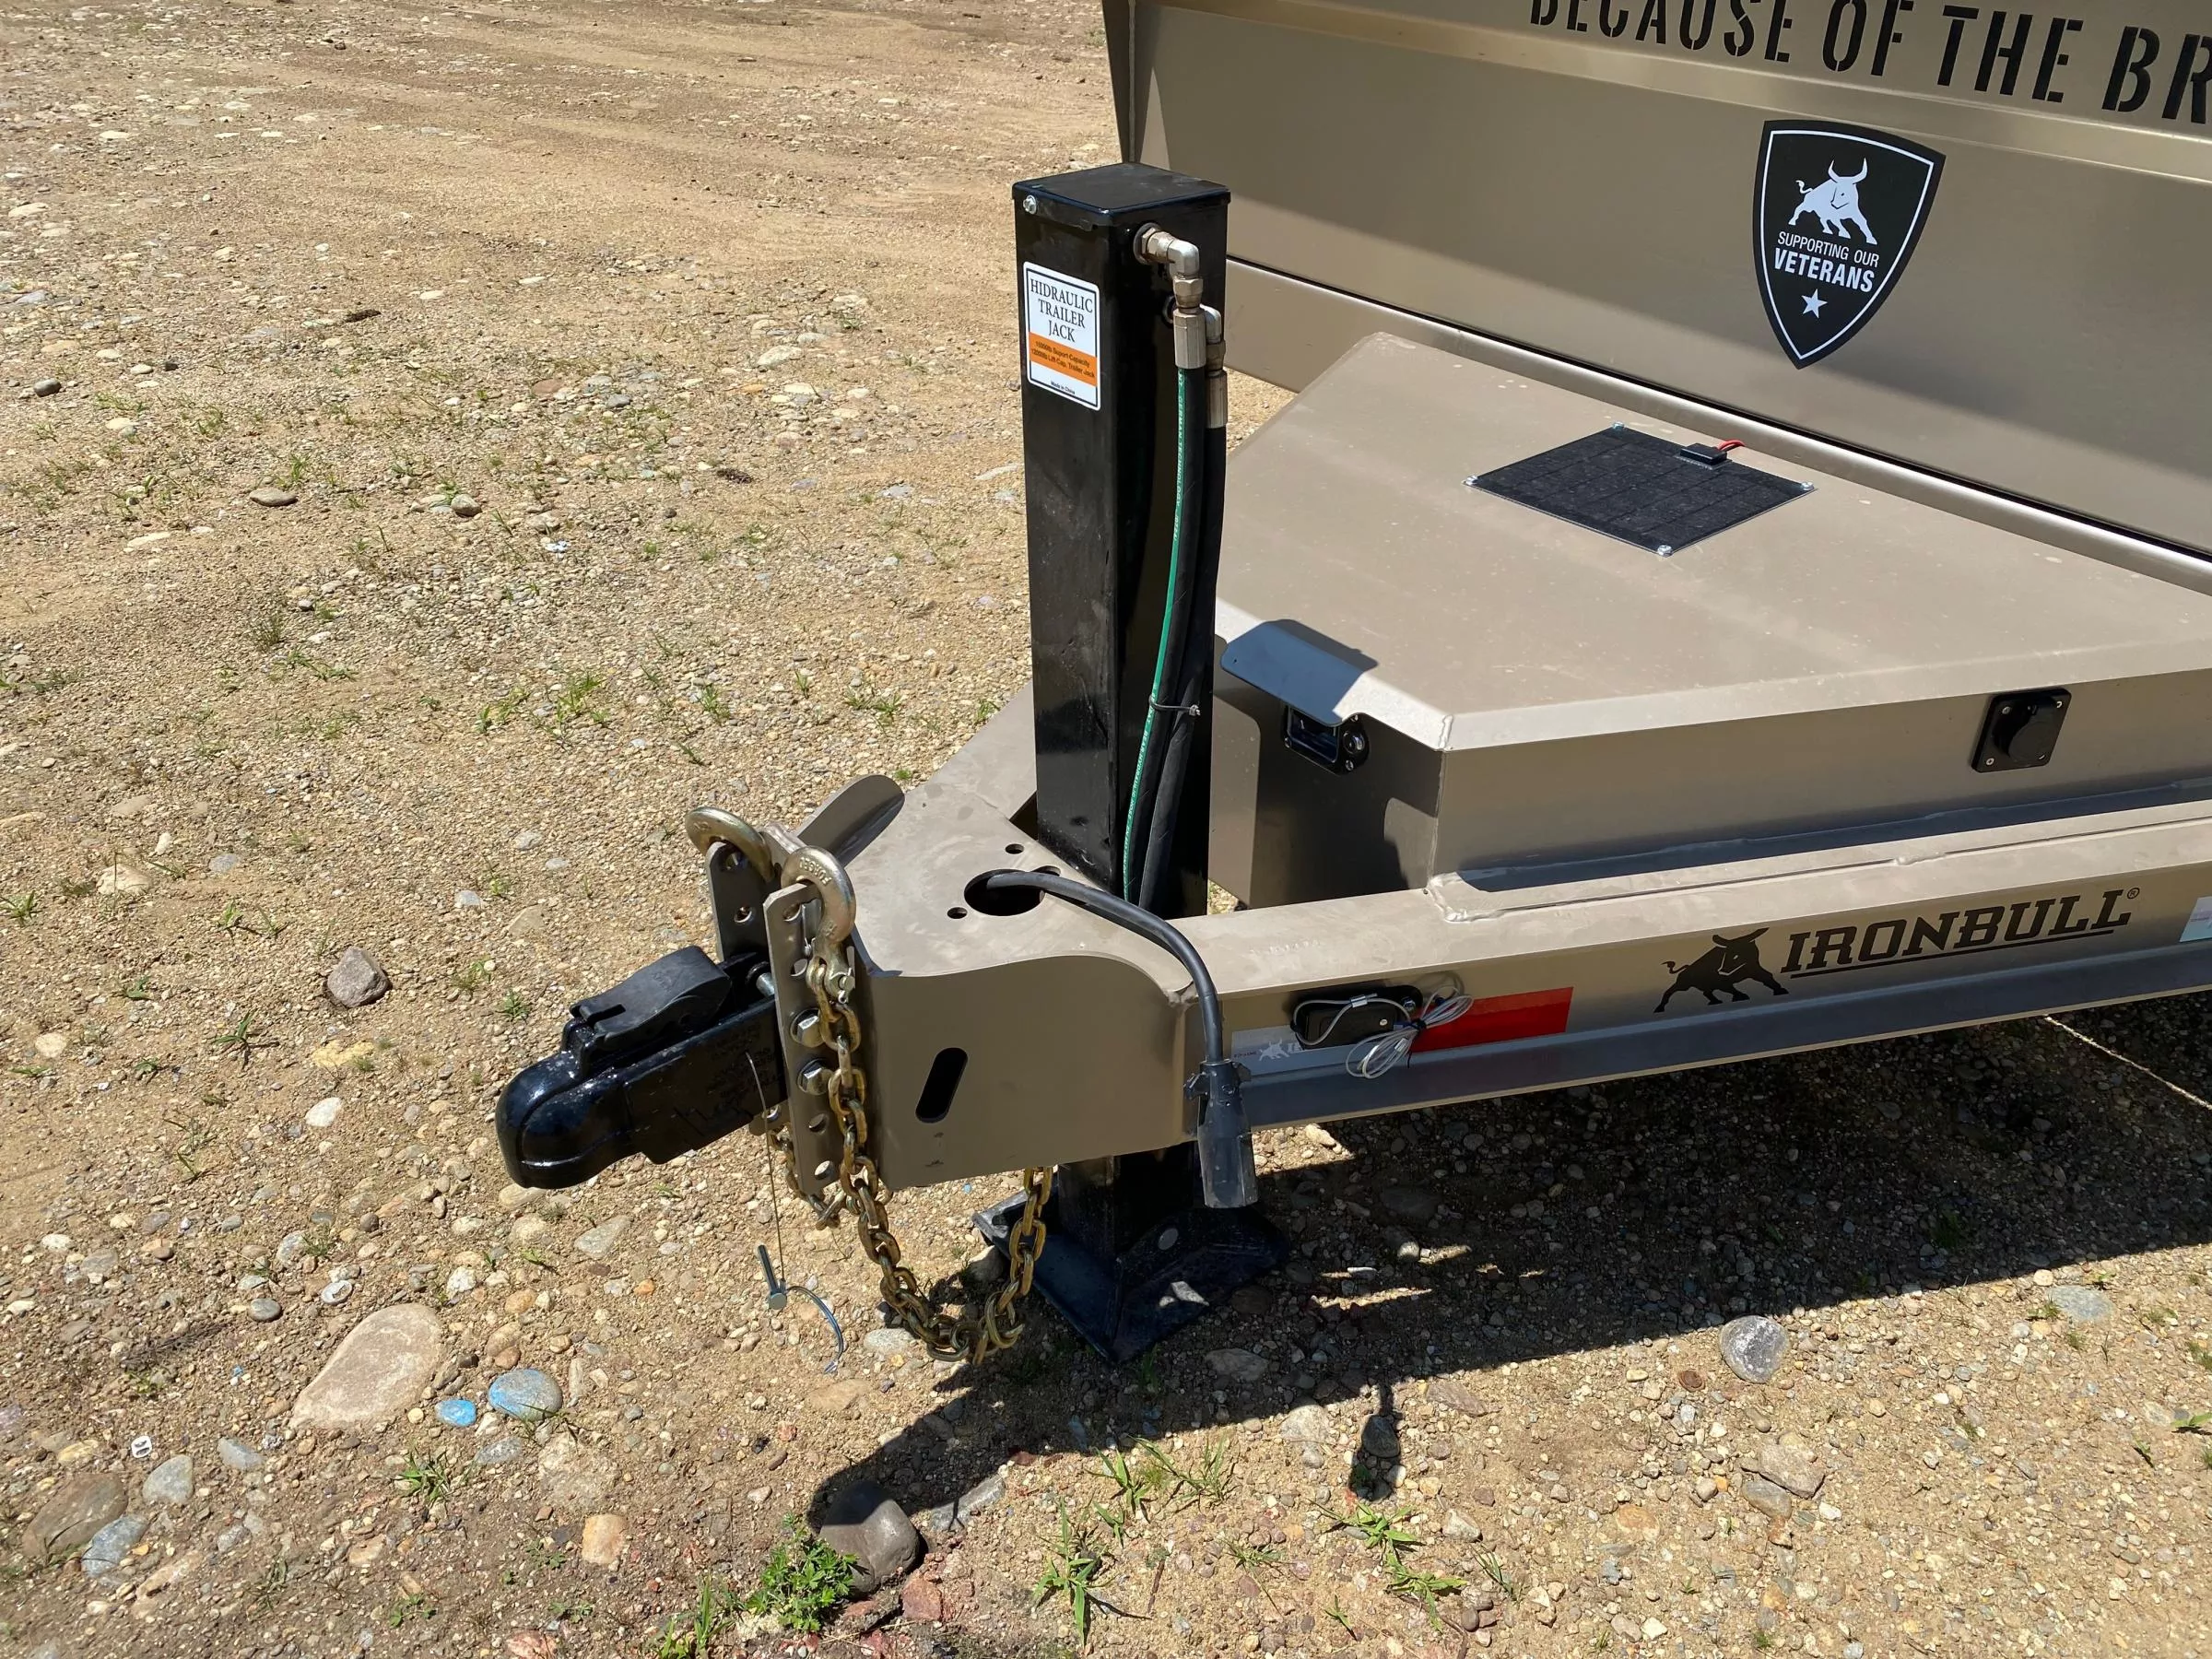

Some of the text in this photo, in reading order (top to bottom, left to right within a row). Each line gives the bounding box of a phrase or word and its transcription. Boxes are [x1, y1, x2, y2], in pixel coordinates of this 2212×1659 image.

[1822, 0, 1918, 77] OF
[1937, 5, 2083, 103] THE
[1777, 230, 1880, 268] SUPPORTING OUR
[1773, 247, 1876, 293] VETERANS
[1030, 278, 1093, 313] HIDRAULIC
[1038, 298, 1086, 329] TRAILER
[1049, 320, 1076, 343] JACK
[1068, 362, 1083, 374] Trailer
[1083, 370, 1095, 378] Jack
[1069, 353, 1090, 369] Capacity
[1051, 381, 1061, 389] Made
[1065, 386, 1076, 395] China
[1131, 753, 1144, 797] HYDRAULIC
